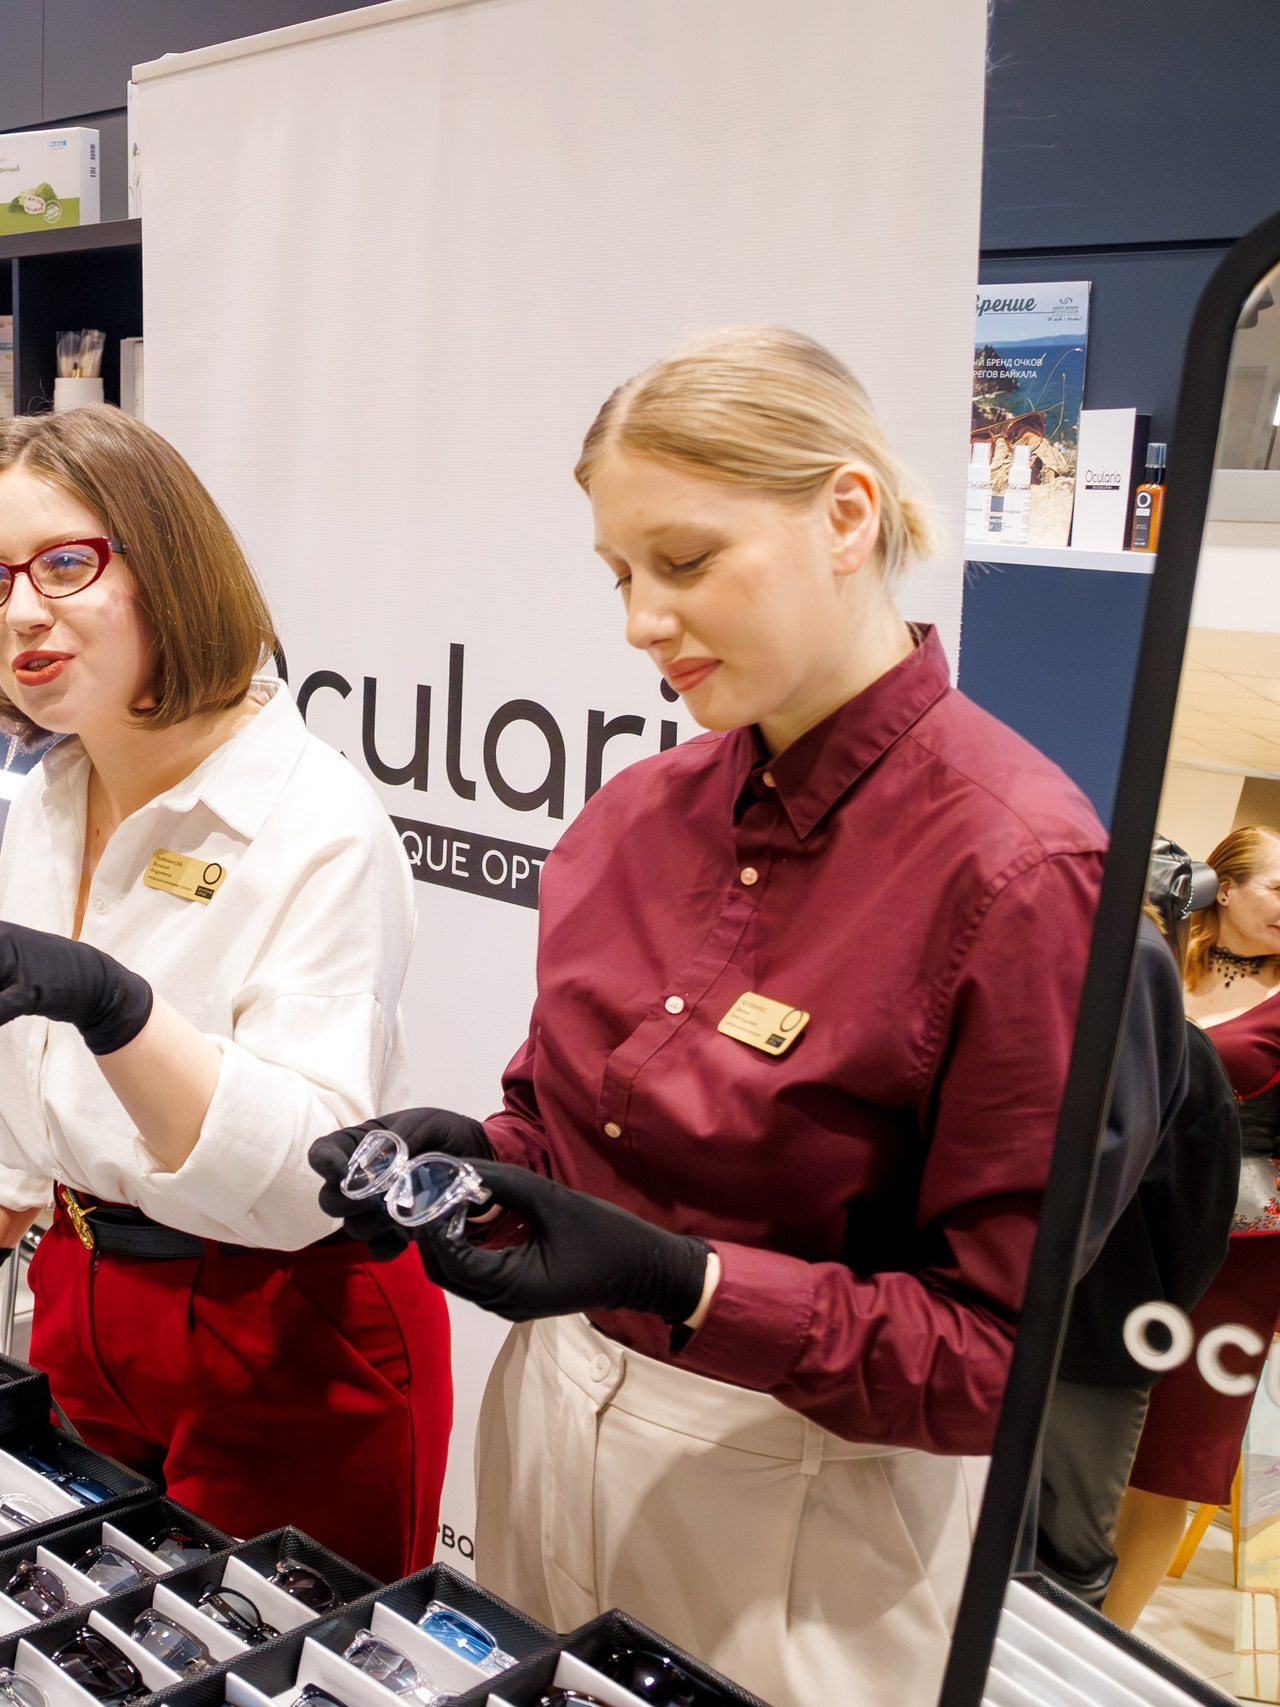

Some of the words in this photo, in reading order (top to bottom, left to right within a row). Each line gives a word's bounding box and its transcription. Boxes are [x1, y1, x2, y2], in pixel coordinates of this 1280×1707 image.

[986, 358, 1013, 368] БРЕНД
[1013, 358, 1043, 367] ОЧКОВ
[999, 368, 1038, 379] БАЙКАЛА
[1085, 469, 1122, 483] Ocularia
[275, 642, 678, 820] cular
[400, 830, 470, 878] QUE
